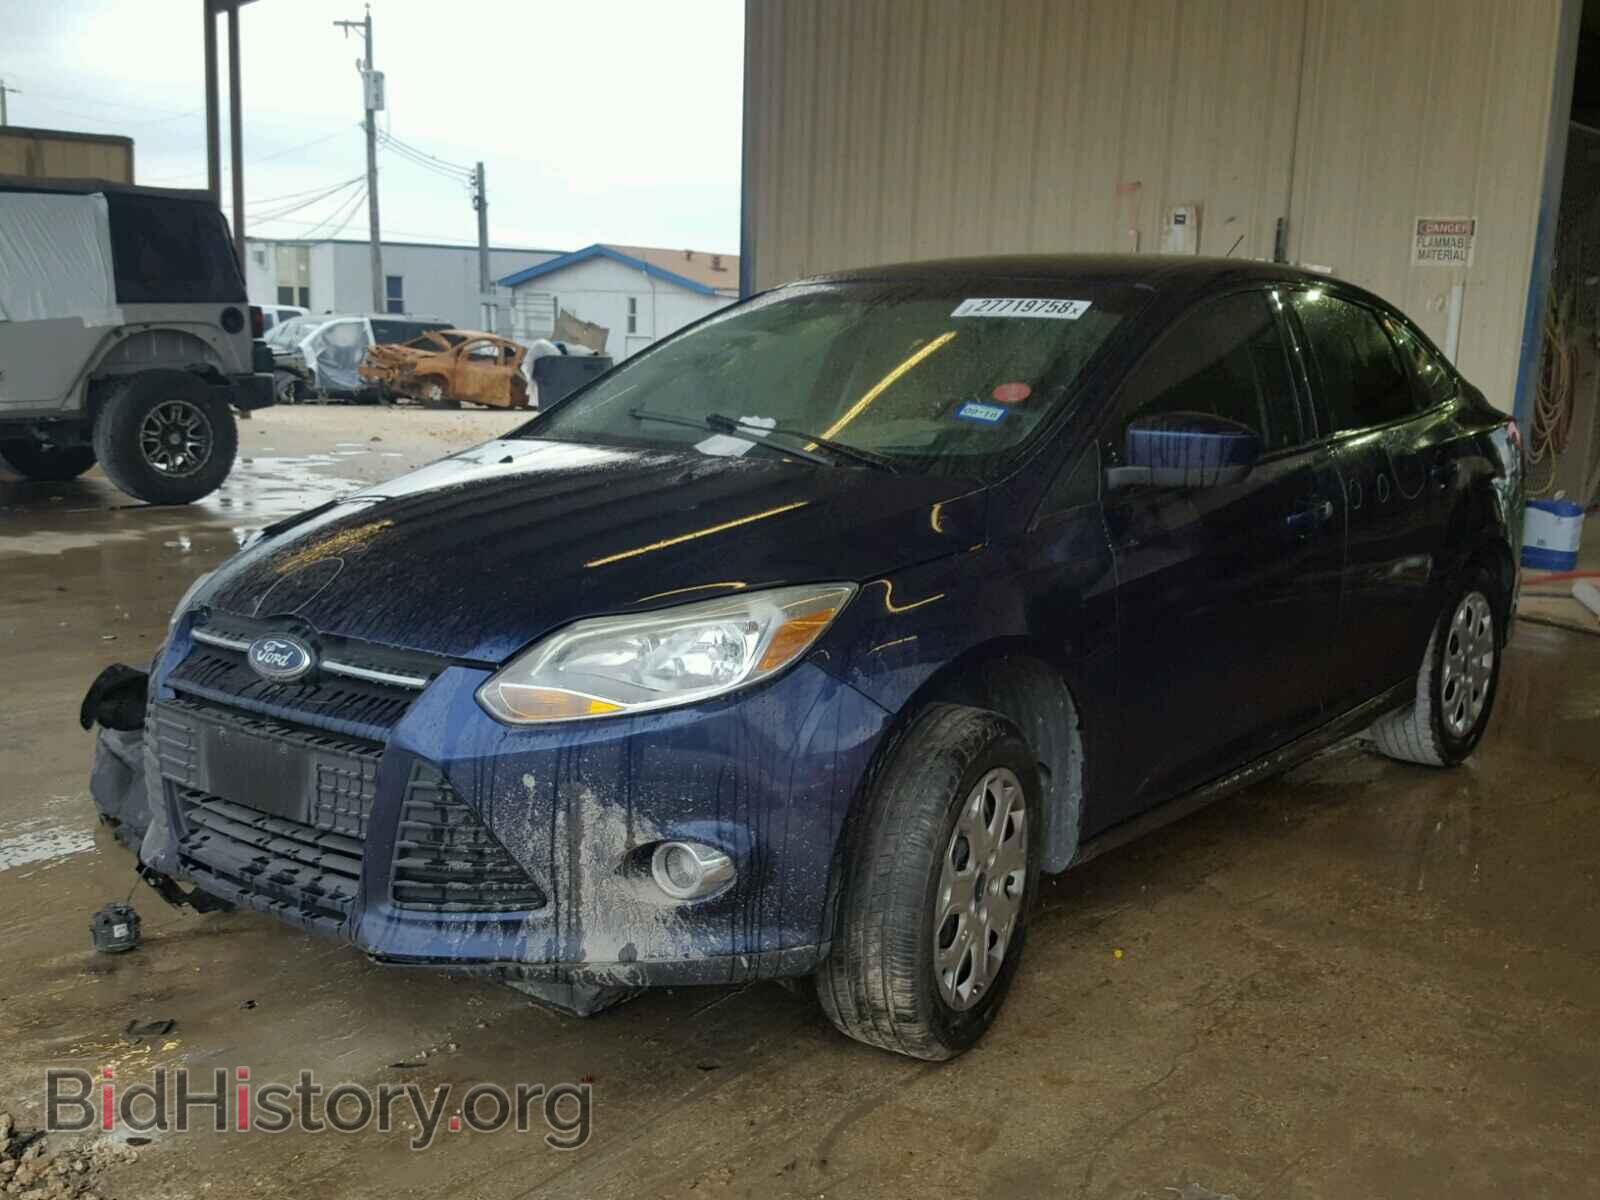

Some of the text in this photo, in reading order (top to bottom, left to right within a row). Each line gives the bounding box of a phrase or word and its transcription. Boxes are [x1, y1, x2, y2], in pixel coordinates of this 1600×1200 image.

[1417, 236, 1473, 248] FLAMMABE
[1418, 249, 1465, 261] MATERIAL
[974, 300, 1075, 314] 27719758
[256, 640, 294, 667] Ford
